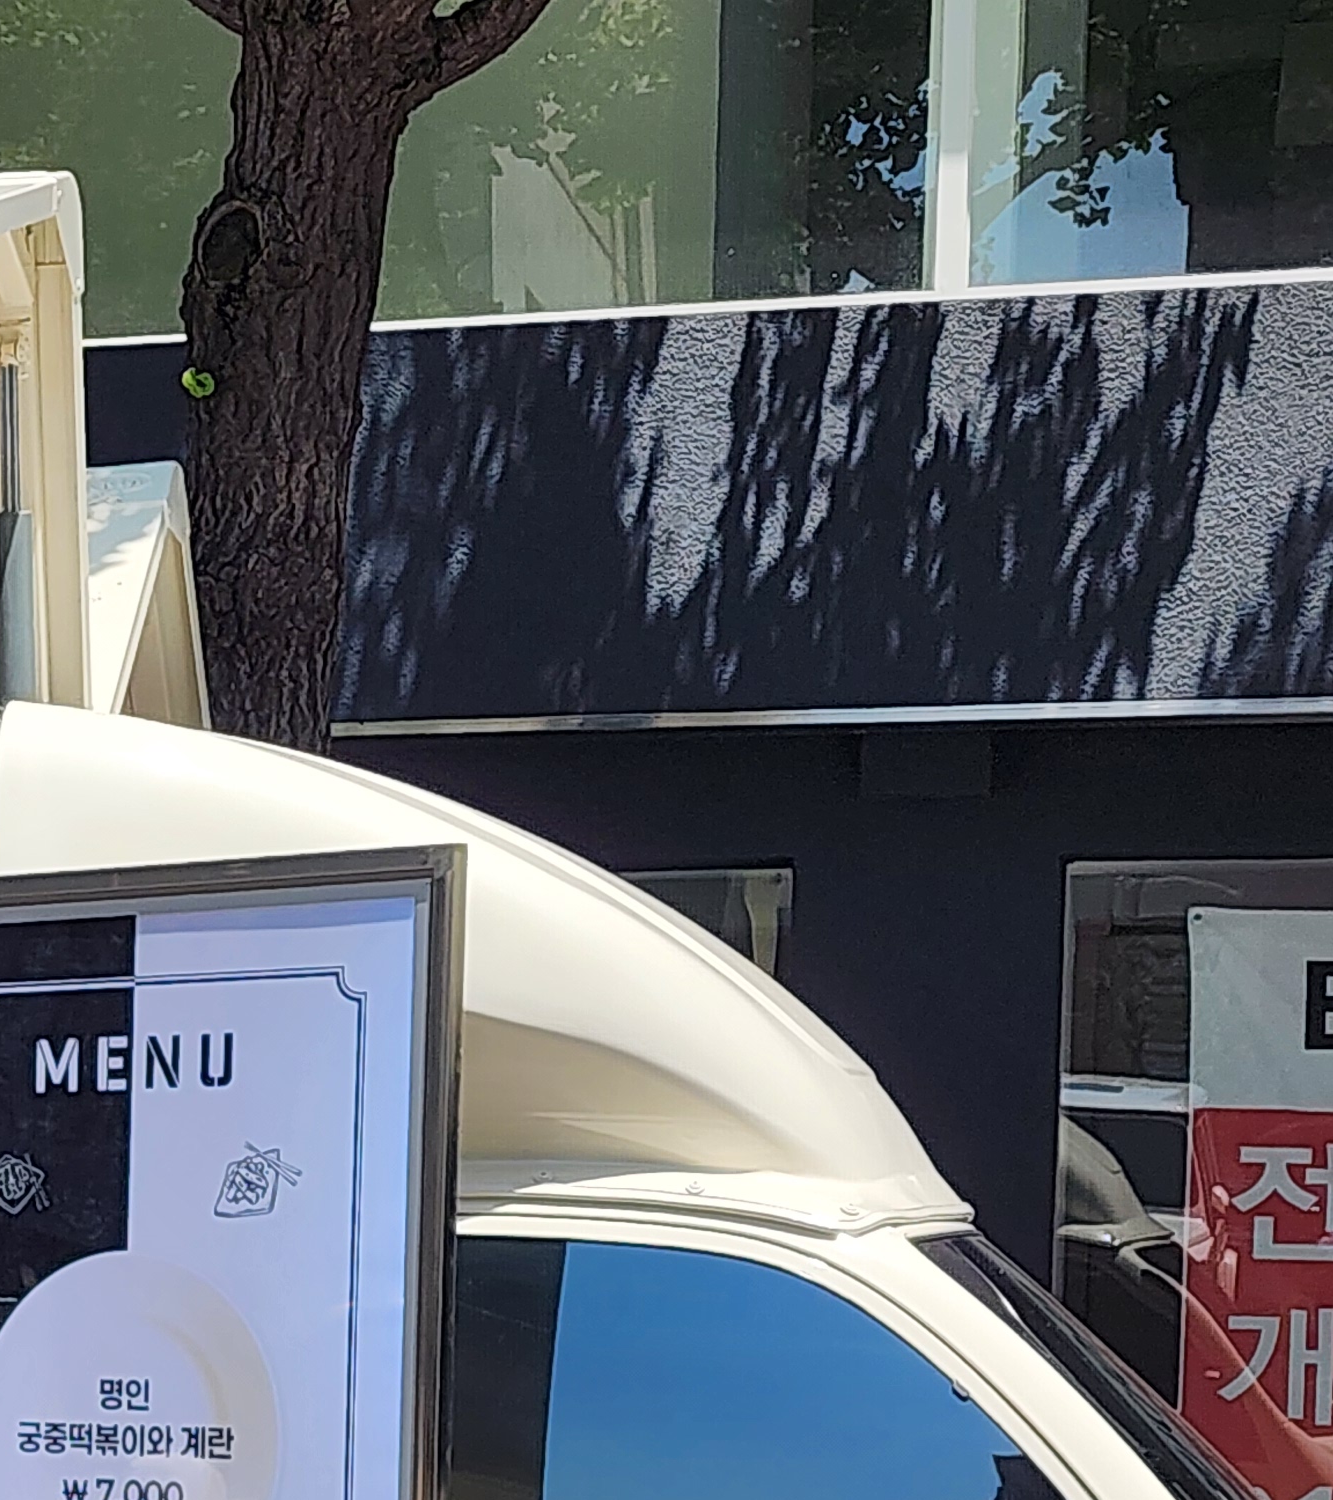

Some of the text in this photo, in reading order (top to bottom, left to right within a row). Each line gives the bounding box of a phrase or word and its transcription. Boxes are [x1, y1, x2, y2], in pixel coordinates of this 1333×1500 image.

[34, 1032, 235, 1095] MENU
[99, 1378, 151, 1411] 명인
[17, 1420, 235, 1460] 궁중떡볶이와 계란
